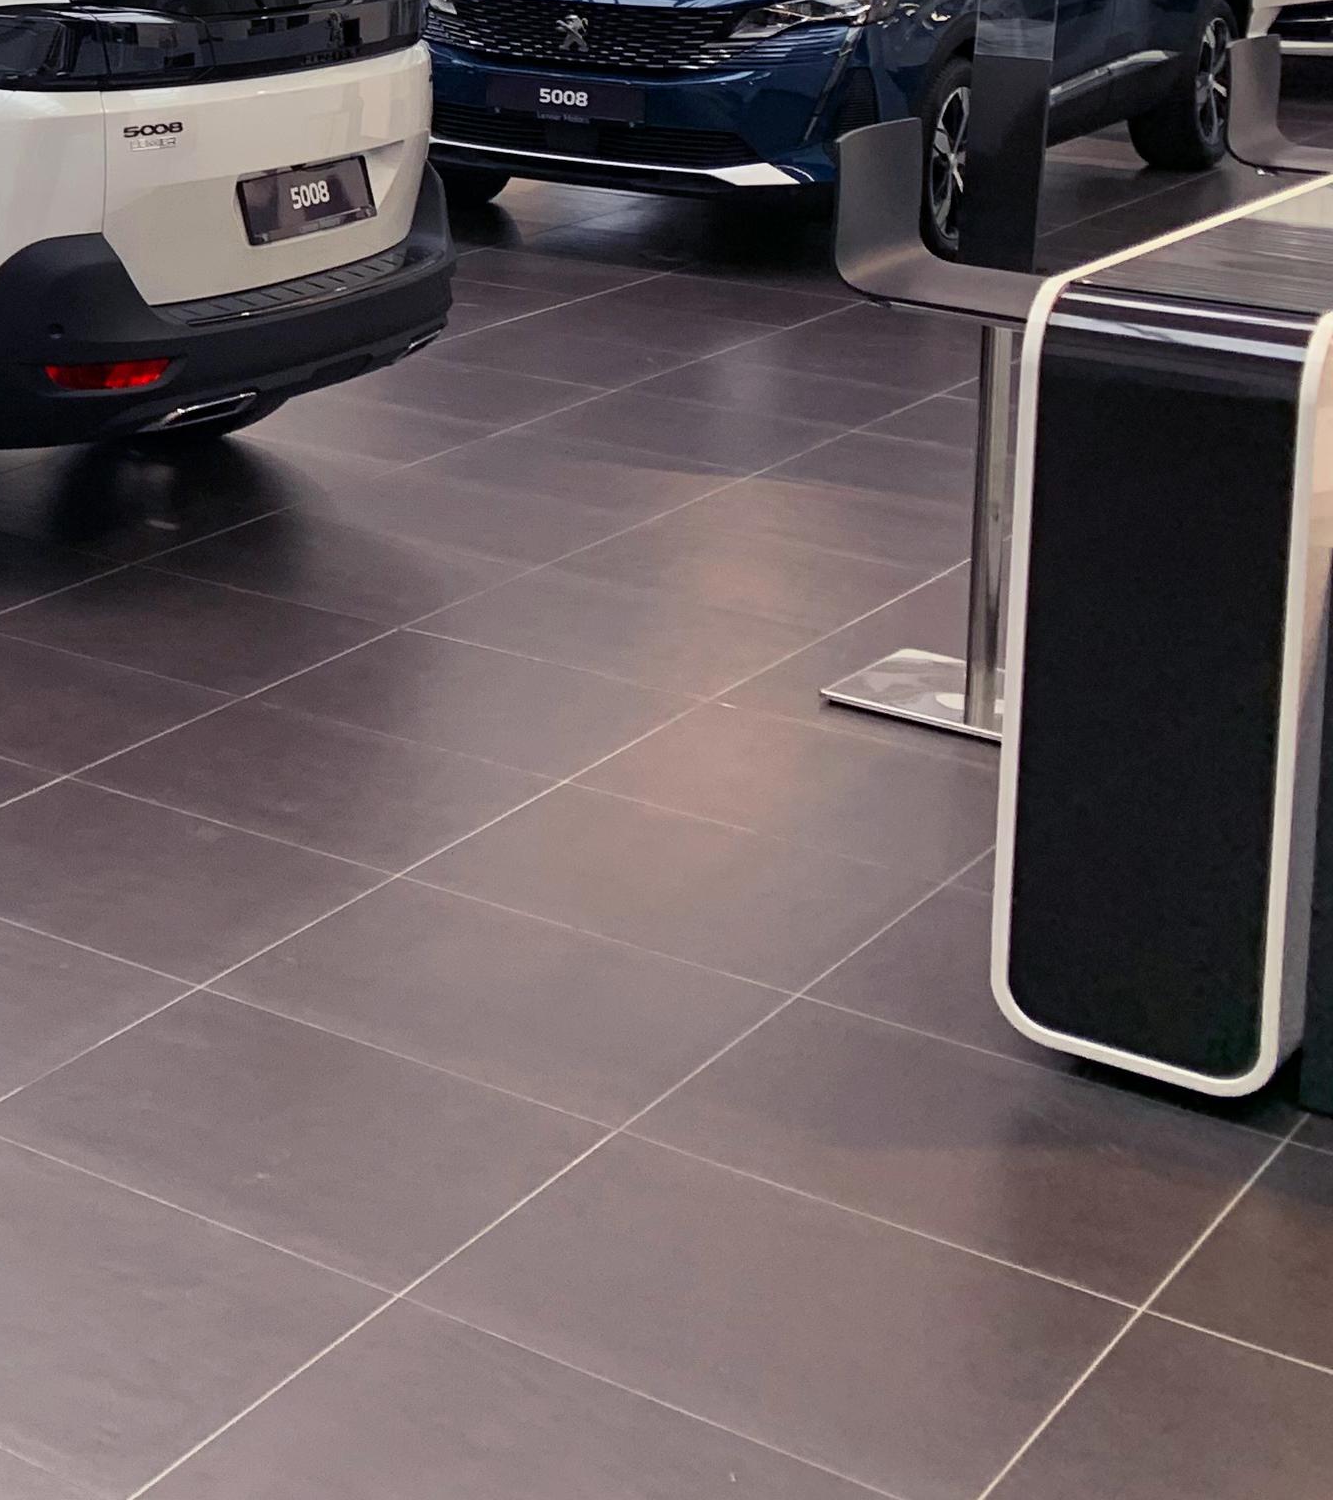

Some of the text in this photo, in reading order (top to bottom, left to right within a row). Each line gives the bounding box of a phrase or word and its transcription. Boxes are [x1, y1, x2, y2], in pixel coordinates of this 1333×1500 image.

[539, 87, 589, 107] 5008
[123, 121, 184, 138] 5008
[290, 180, 331, 210] 5008
